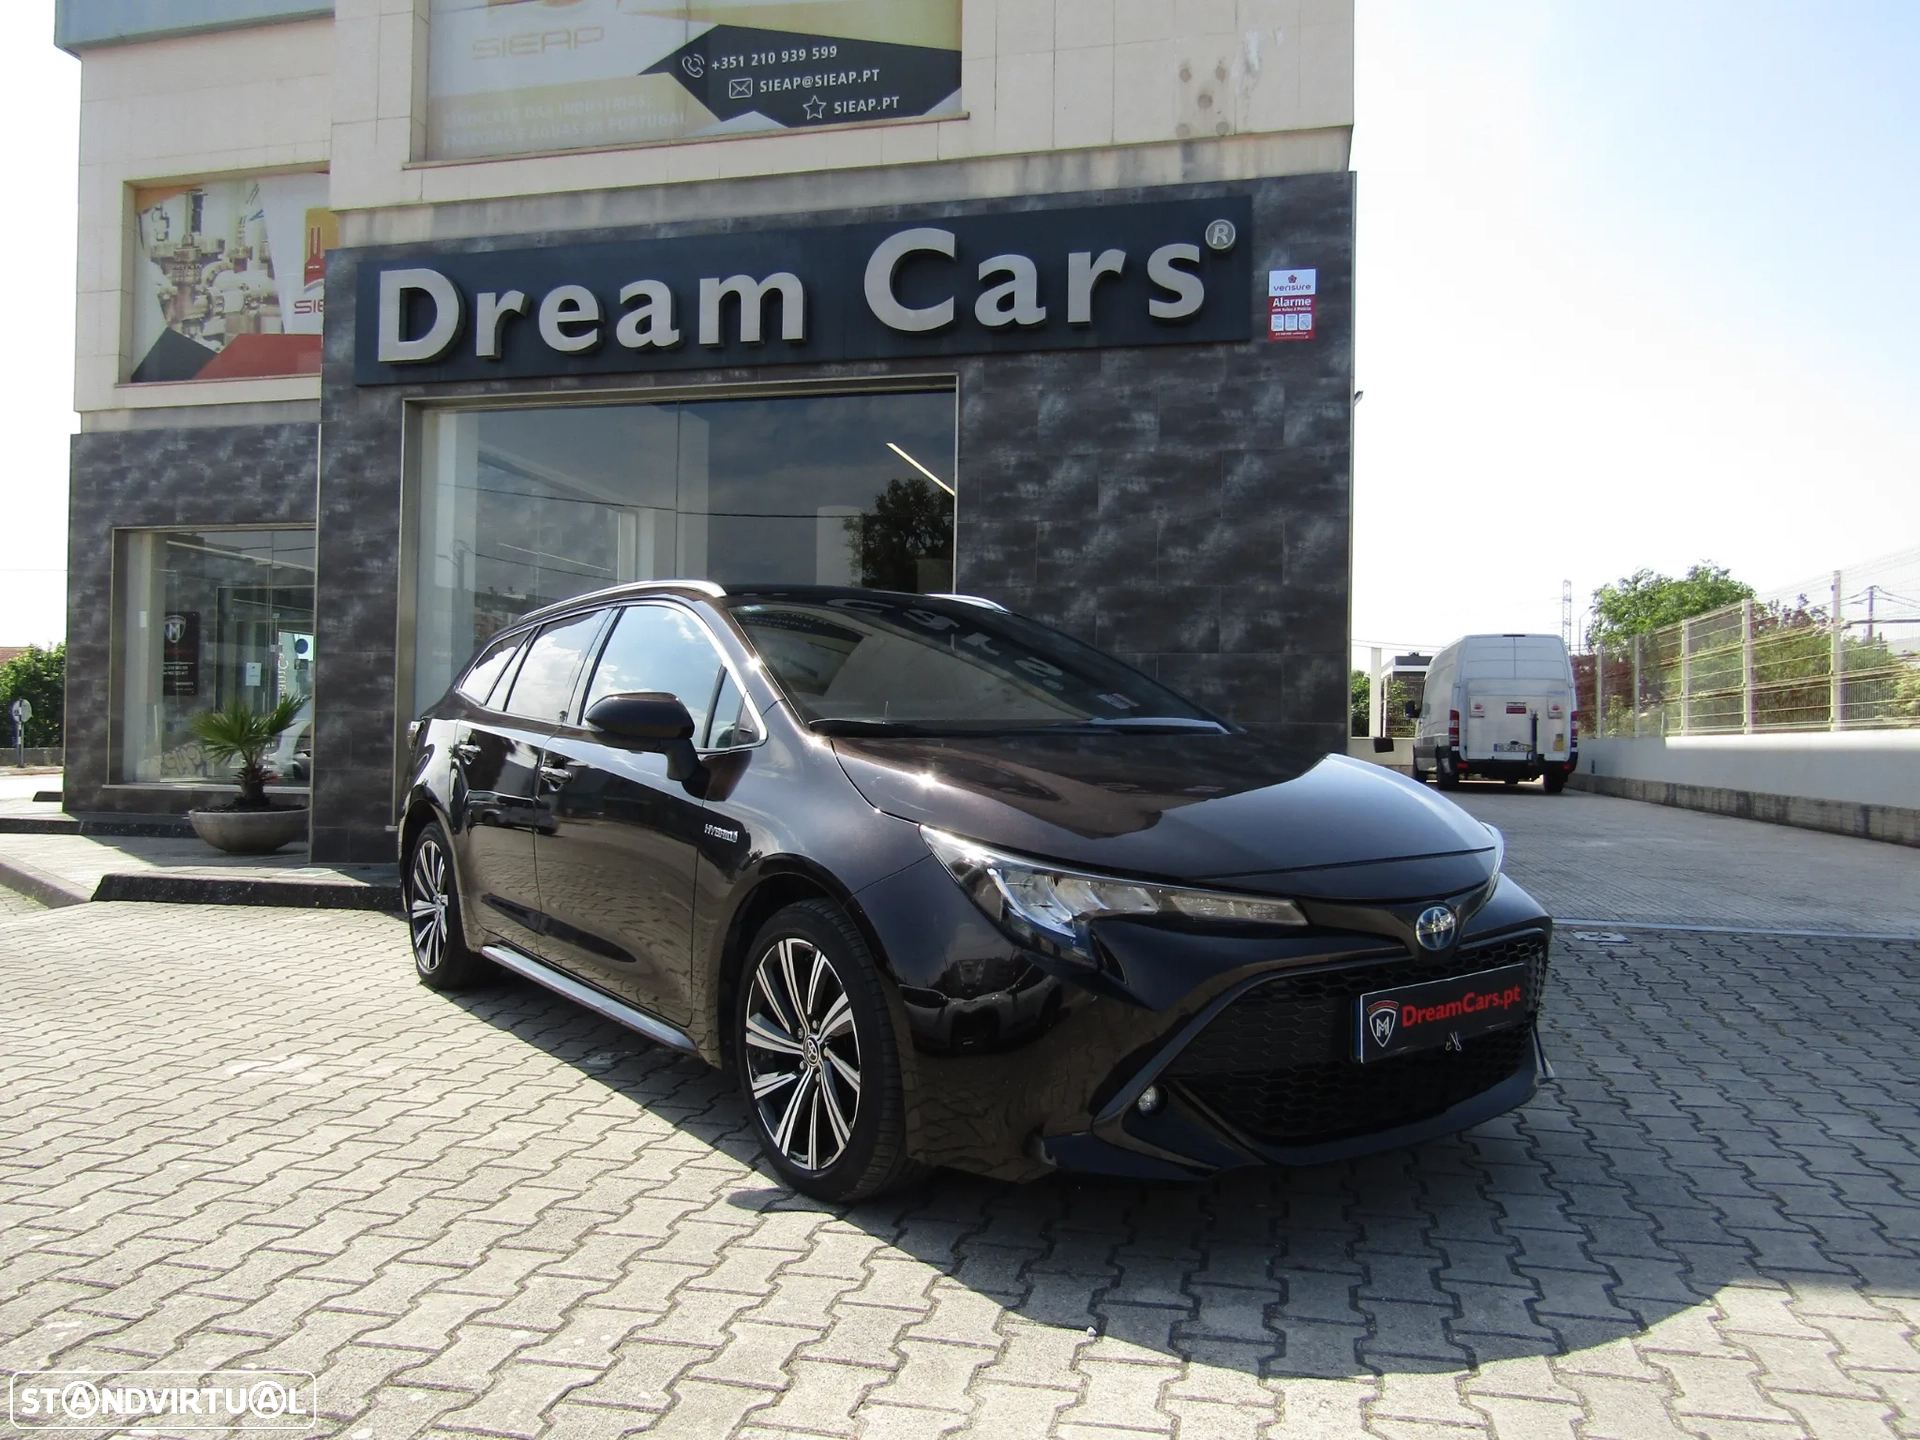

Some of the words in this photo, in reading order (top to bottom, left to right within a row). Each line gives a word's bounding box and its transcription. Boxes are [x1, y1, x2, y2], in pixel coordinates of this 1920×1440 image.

[472, 26, 605, 60] SIEAP
[712, 55, 744, 70] +351
[751, 52, 776, 67] 210
[781, 48, 807, 64] 939
[812, 45, 838, 60] 599
[759, 69, 880, 93] SIEAP@SIEAP.PT
[833, 96, 900, 115] SIEAP.PT
[377, 267, 804, 364] Dream
[863, 226, 1206, 332] Cars
[1273, 284, 1311, 292] verisure
[1272, 297, 1312, 307] Alarme
[1402, 984, 1522, 1027] DreamCars.pt
